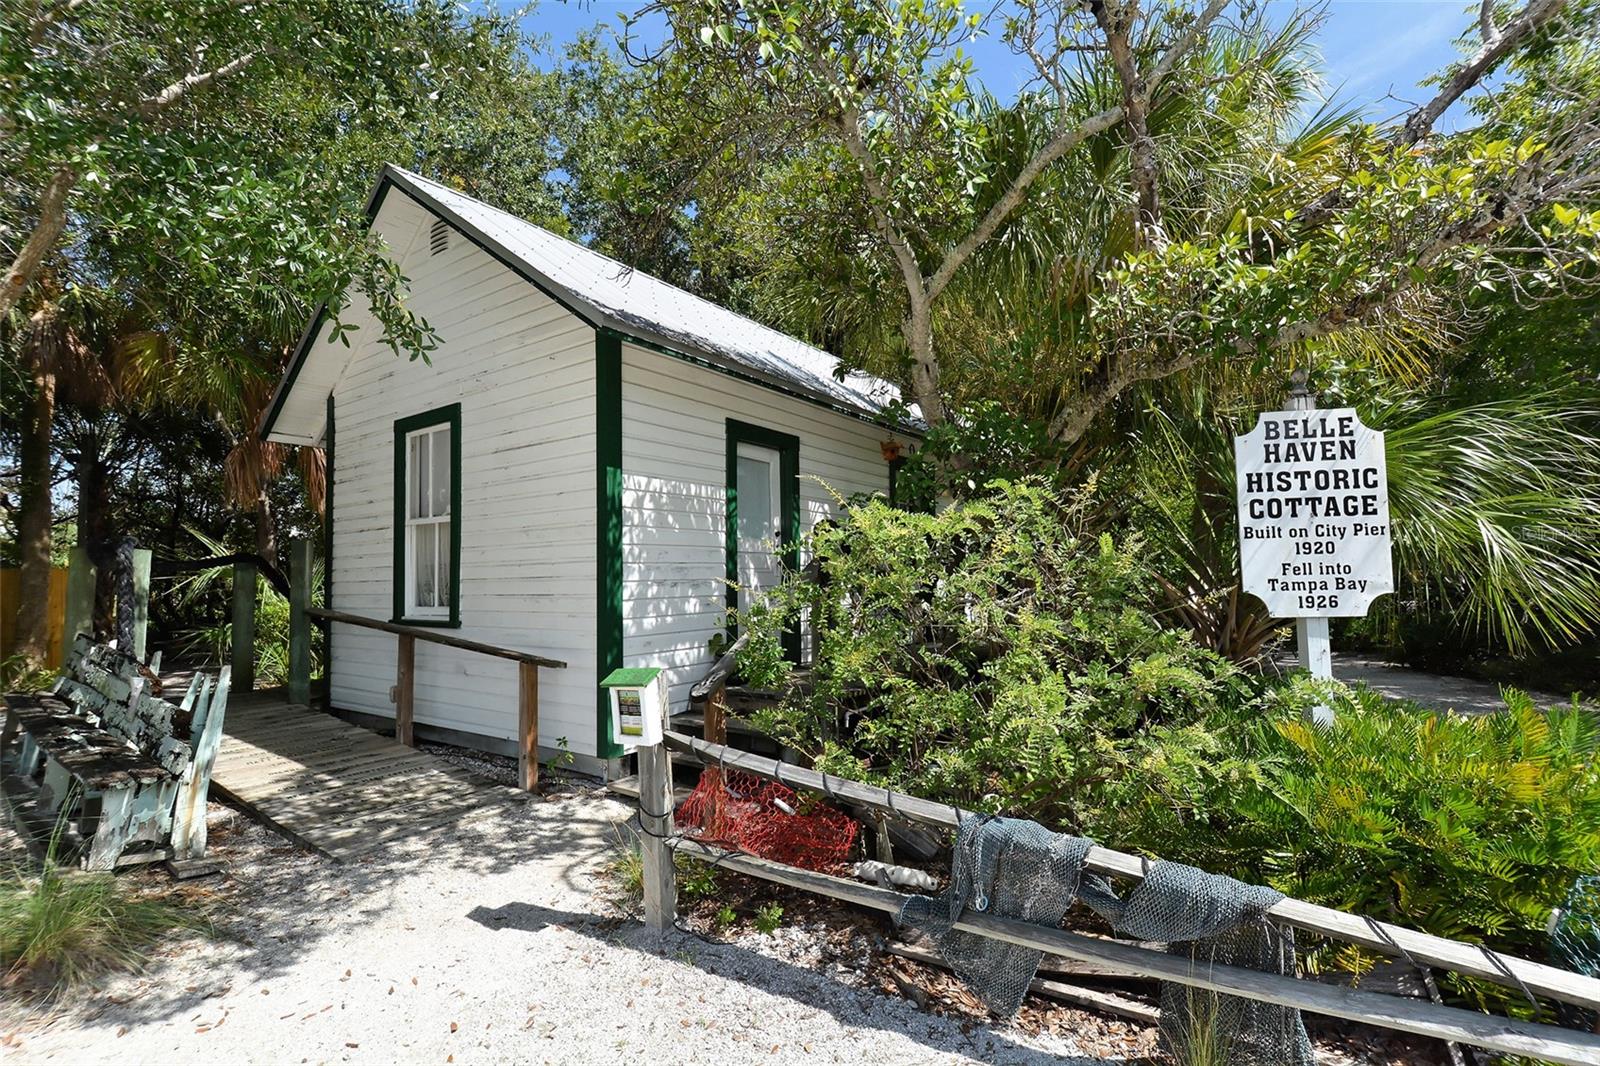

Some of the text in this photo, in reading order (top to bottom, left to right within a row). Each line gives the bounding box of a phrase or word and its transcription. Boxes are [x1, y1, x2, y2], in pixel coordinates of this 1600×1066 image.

[1264, 416, 1354, 440] BELLE
[1263, 440, 1356, 463] HAVEN
[1246, 468, 1378, 493] HISTORIC
[1250, 495, 1378, 519] COTTAGE
[1243, 523, 1387, 540] Built on City Pier
[1294, 541, 1336, 555] 1920
[1281, 562, 1352, 576] Fell into
[1267, 578, 1367, 594] Tampa Bay
[1298, 595, 1339, 609] 1926
